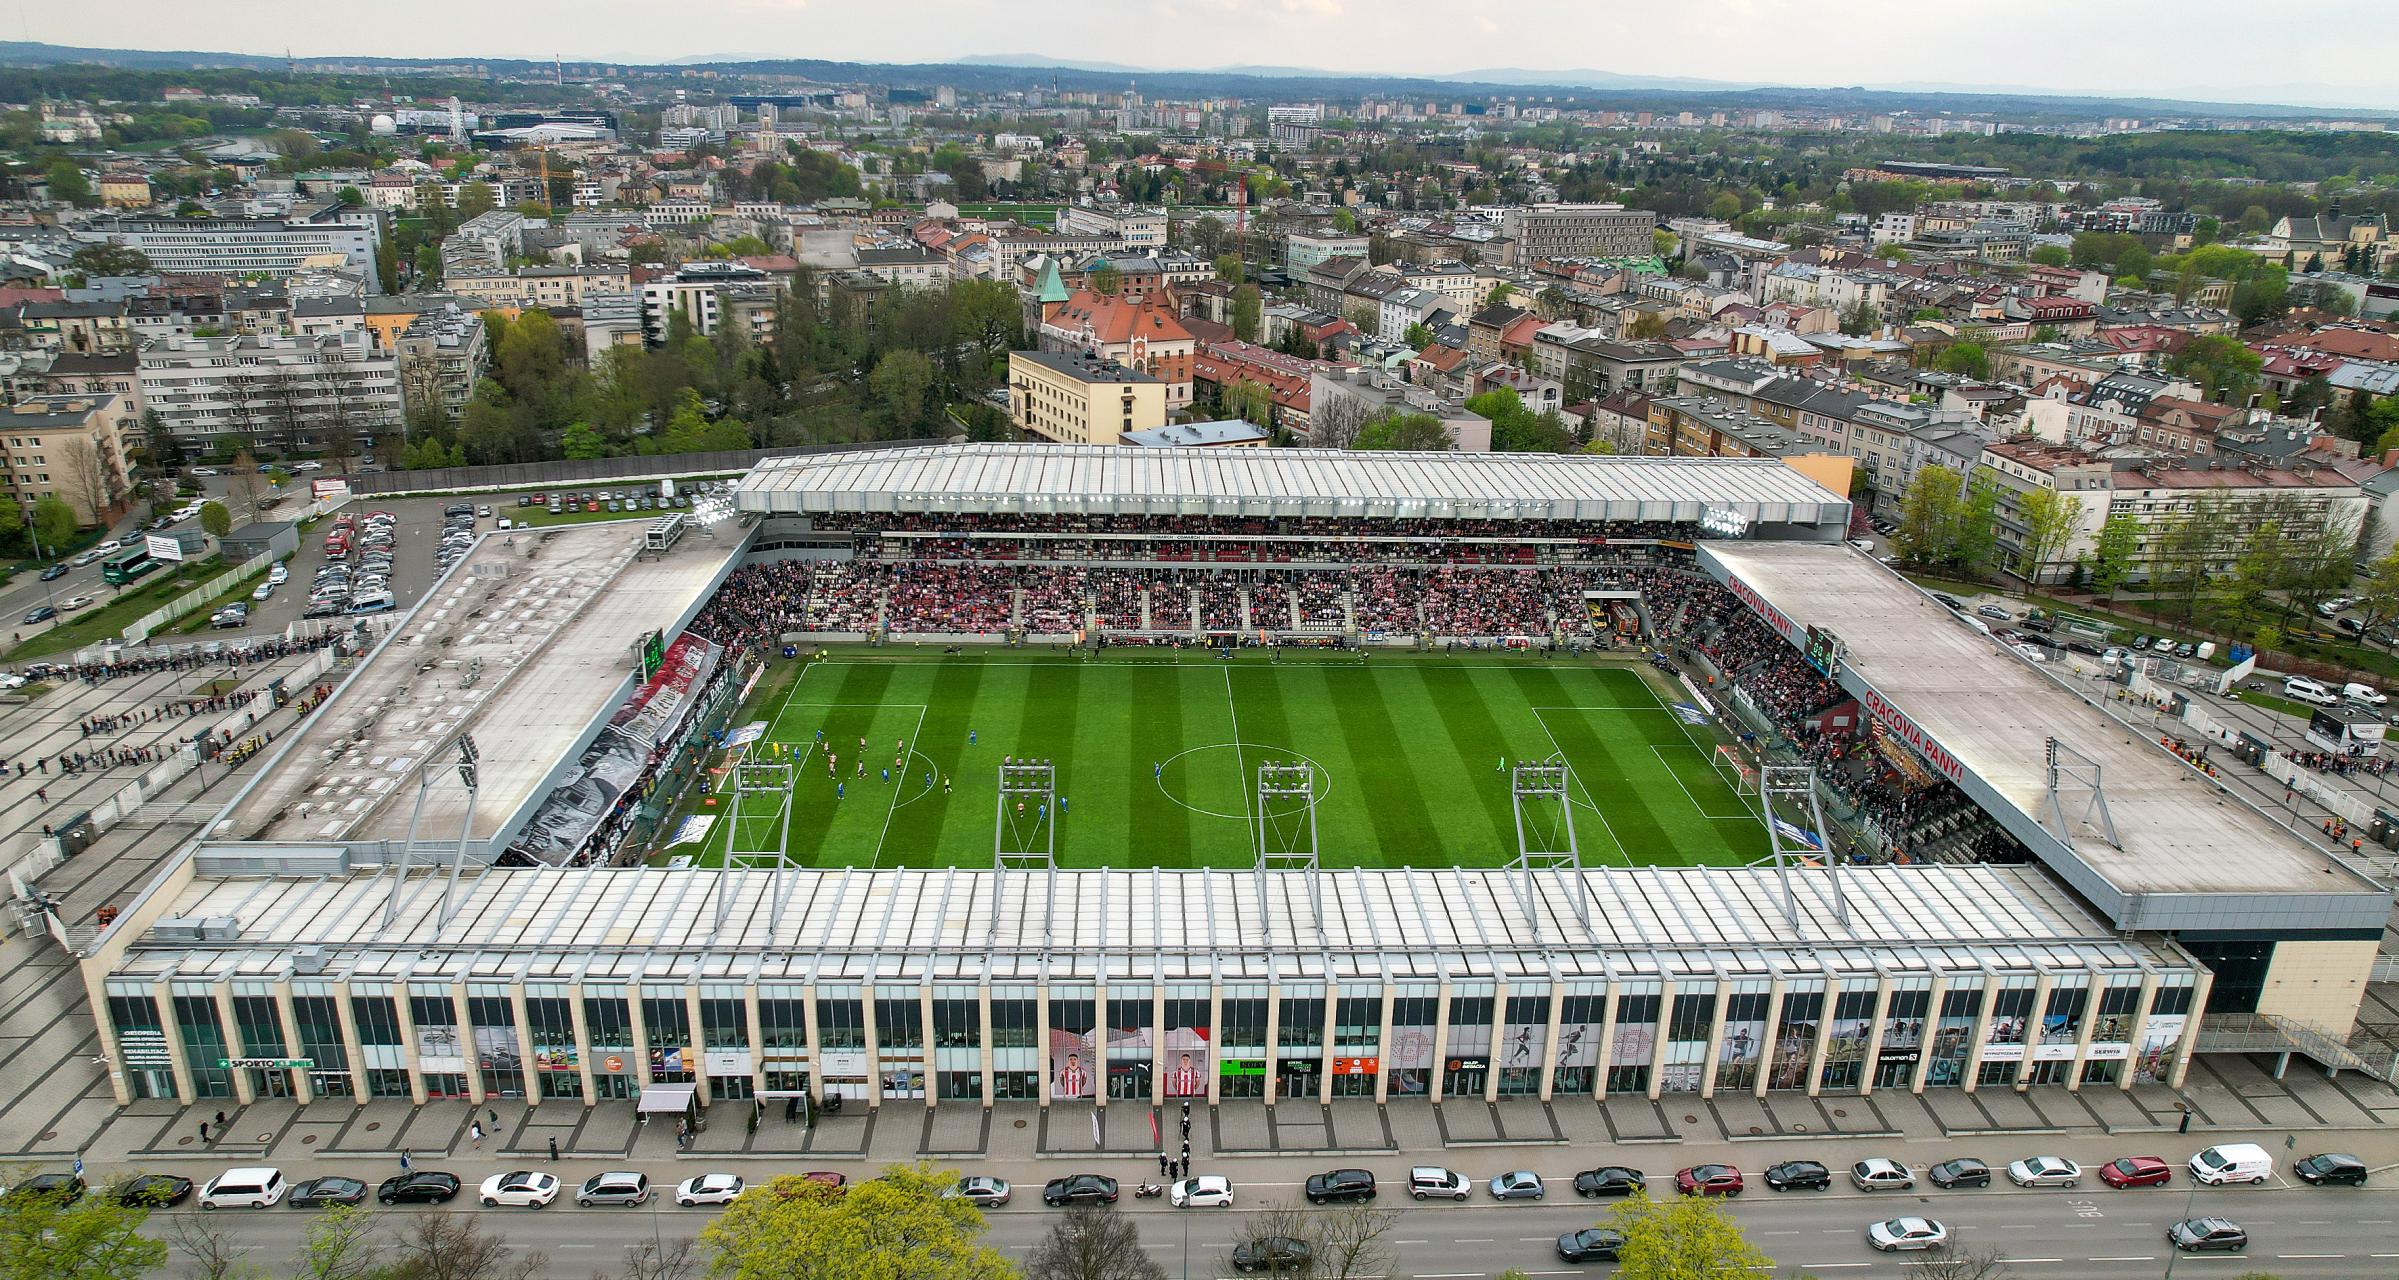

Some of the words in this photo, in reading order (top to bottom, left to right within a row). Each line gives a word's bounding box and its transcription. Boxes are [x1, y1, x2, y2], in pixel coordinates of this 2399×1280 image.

[1728, 575, 1765, 616] CRACOVIA
[1767, 607, 1792, 638] PANY!
[1865, 690, 1921, 748] CRACOVIA
[1925, 739, 1963, 783] PANY!
[2067, 1200, 2104, 1218] BUS
